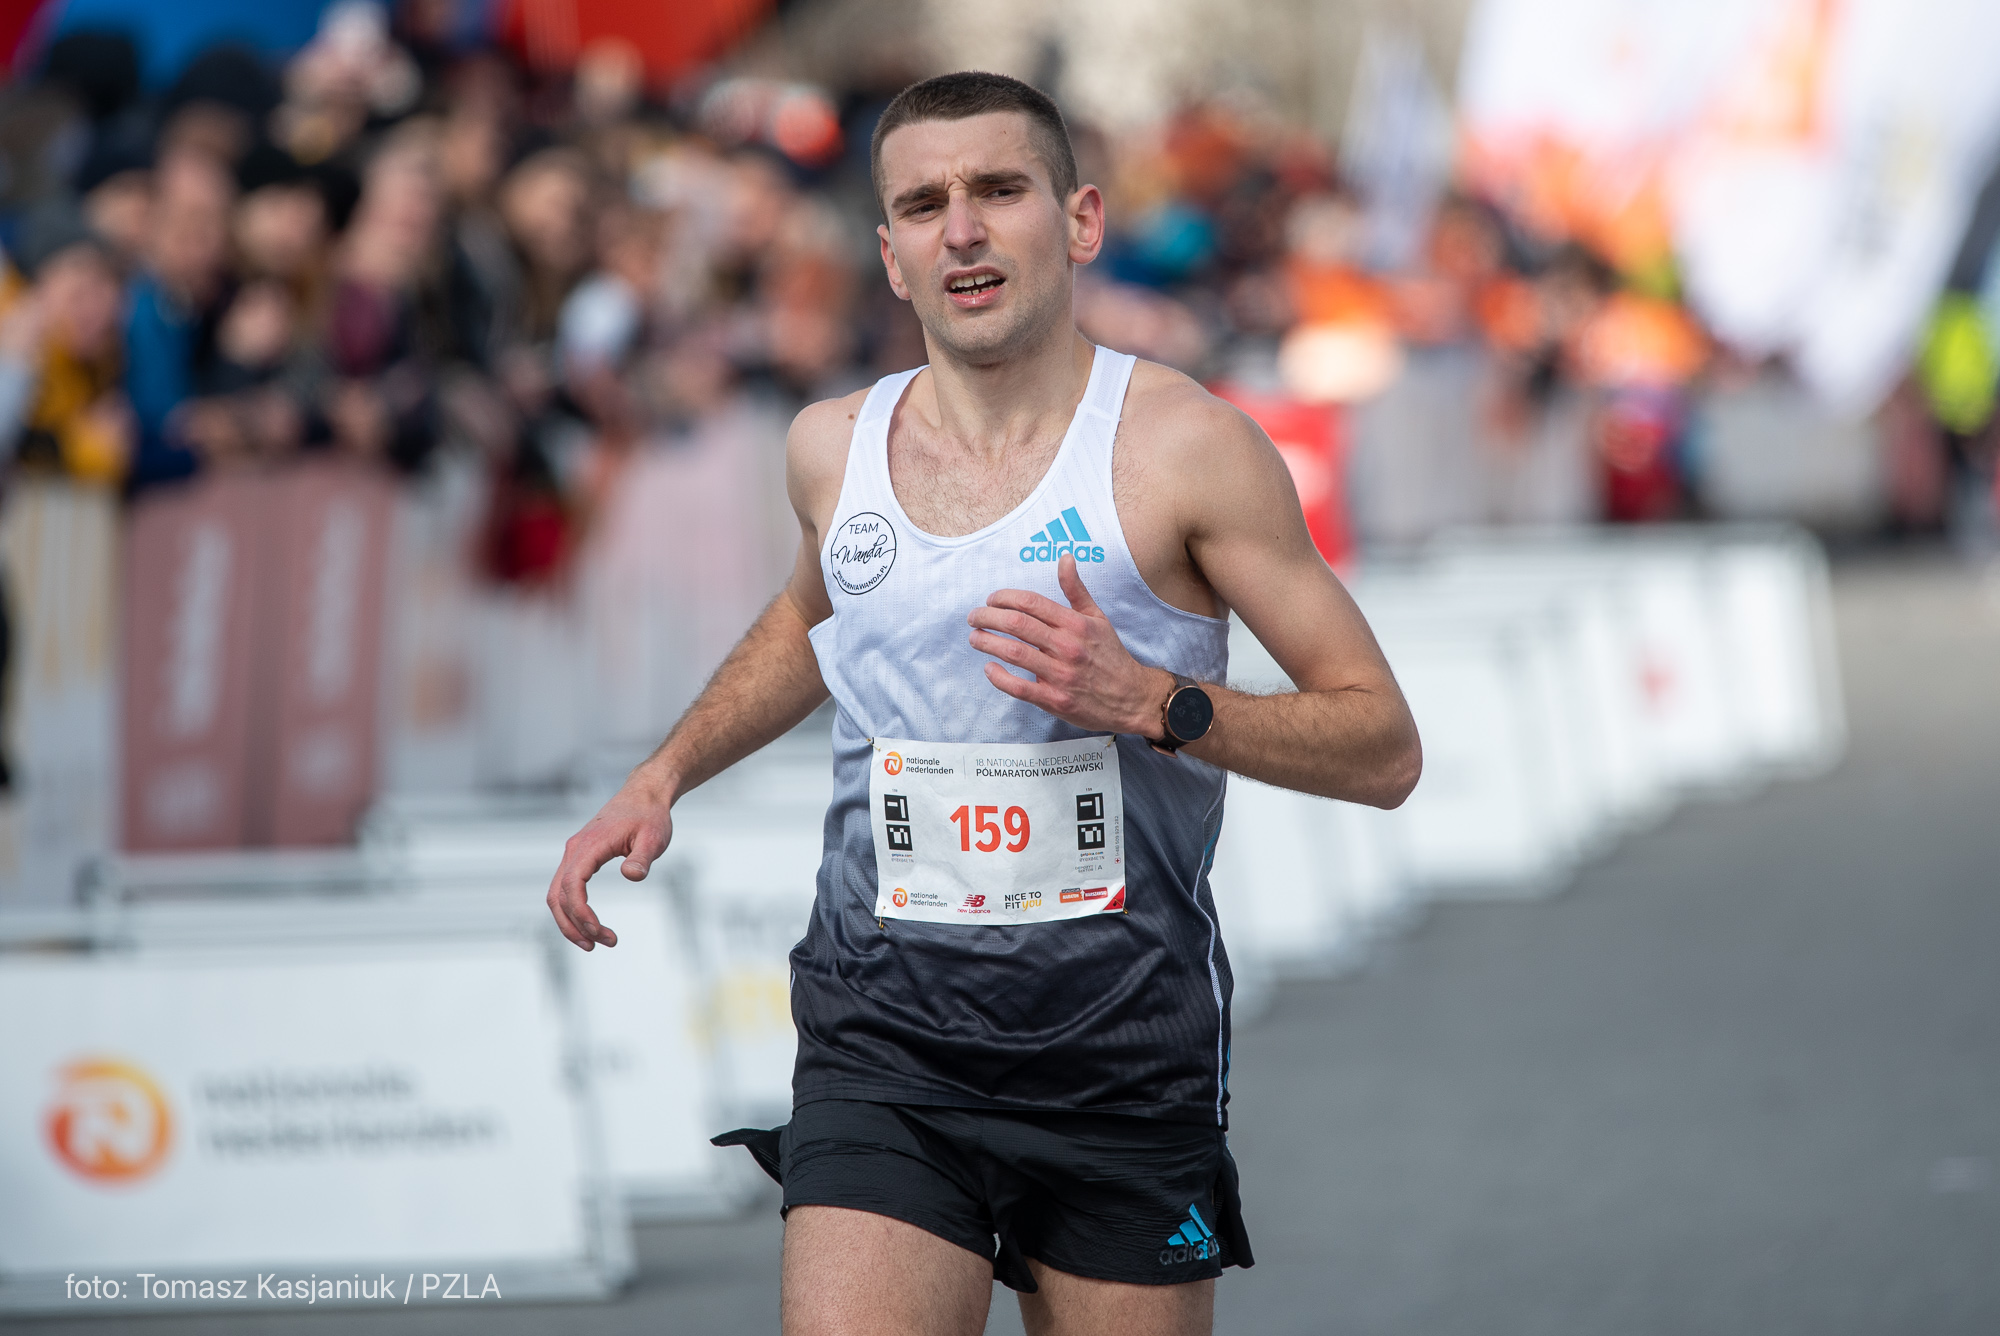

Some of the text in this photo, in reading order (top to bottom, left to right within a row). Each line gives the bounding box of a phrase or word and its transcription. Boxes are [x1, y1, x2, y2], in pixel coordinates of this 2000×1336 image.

[848, 522, 879, 535] TEAM
[1019, 540, 1105, 563] adidas
[906, 757, 940, 765] nationale
[986, 751, 1103, 768] NATIONALE-NEDERLANDEN
[905, 766, 954, 775] nederlanden
[976, 761, 1104, 778] PÓŁMARATON WARSZAWSKI
[950, 805, 1031, 853] 159
[910, 892, 938, 900] nationale
[1004, 891, 1042, 902] NICE TO
[910, 899, 948, 908] nederlanden
[1005, 899, 1042, 913] FIT you
